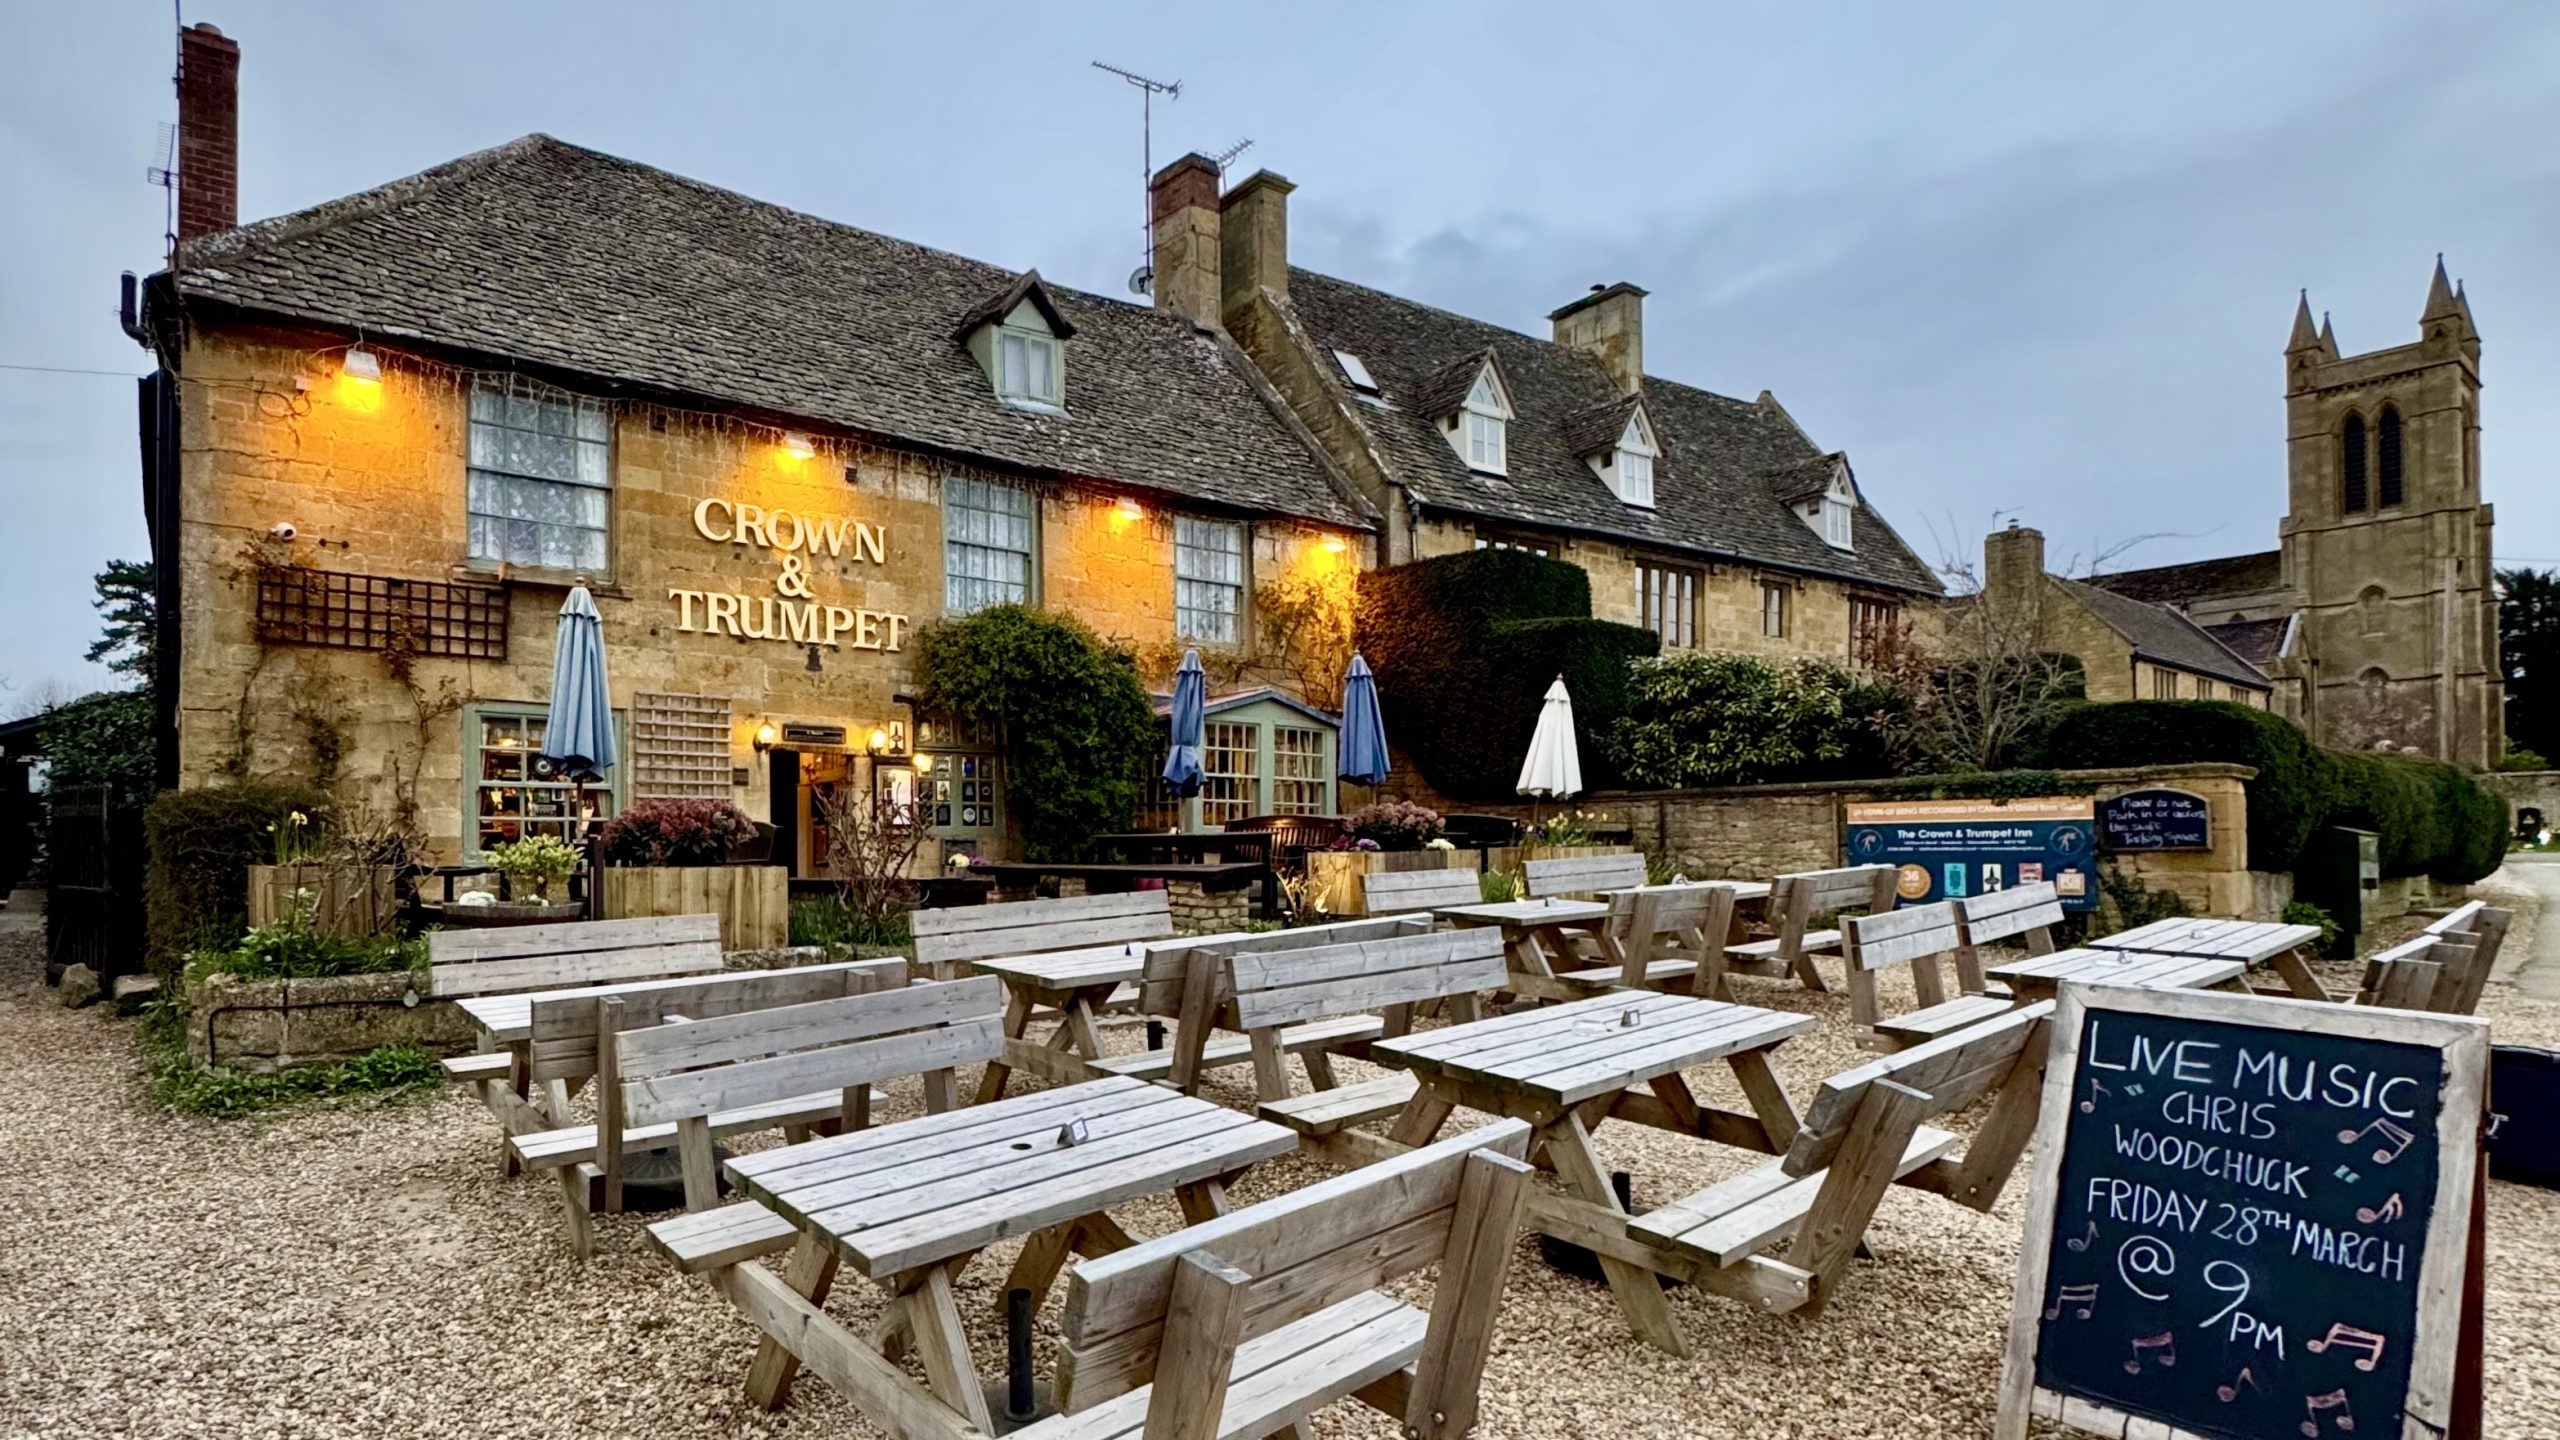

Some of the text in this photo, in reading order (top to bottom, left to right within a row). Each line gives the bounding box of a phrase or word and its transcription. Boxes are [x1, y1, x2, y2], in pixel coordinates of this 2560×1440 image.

[694, 498, 886, 565] CROWN
[776, 554, 814, 599] &
[668, 588, 909, 652] TRUMPET
[1897, 828, 2033, 840] The Crown & Trumpet Inn
[2107, 809, 2138, 820] Park
[2140, 809, 2153, 818] in
[1903, 870, 1920, 881] 36
[2089, 1020, 2419, 1119] LIVE MUSIC
[2162, 1090, 2276, 1140] CHRIS
[2114, 1123, 2310, 1199] WOODCHUCK
[2087, 1177, 2405, 1282] FRIDAY 28TH MARCH
[2117, 1234, 2286, 1361] @ 9 PM
